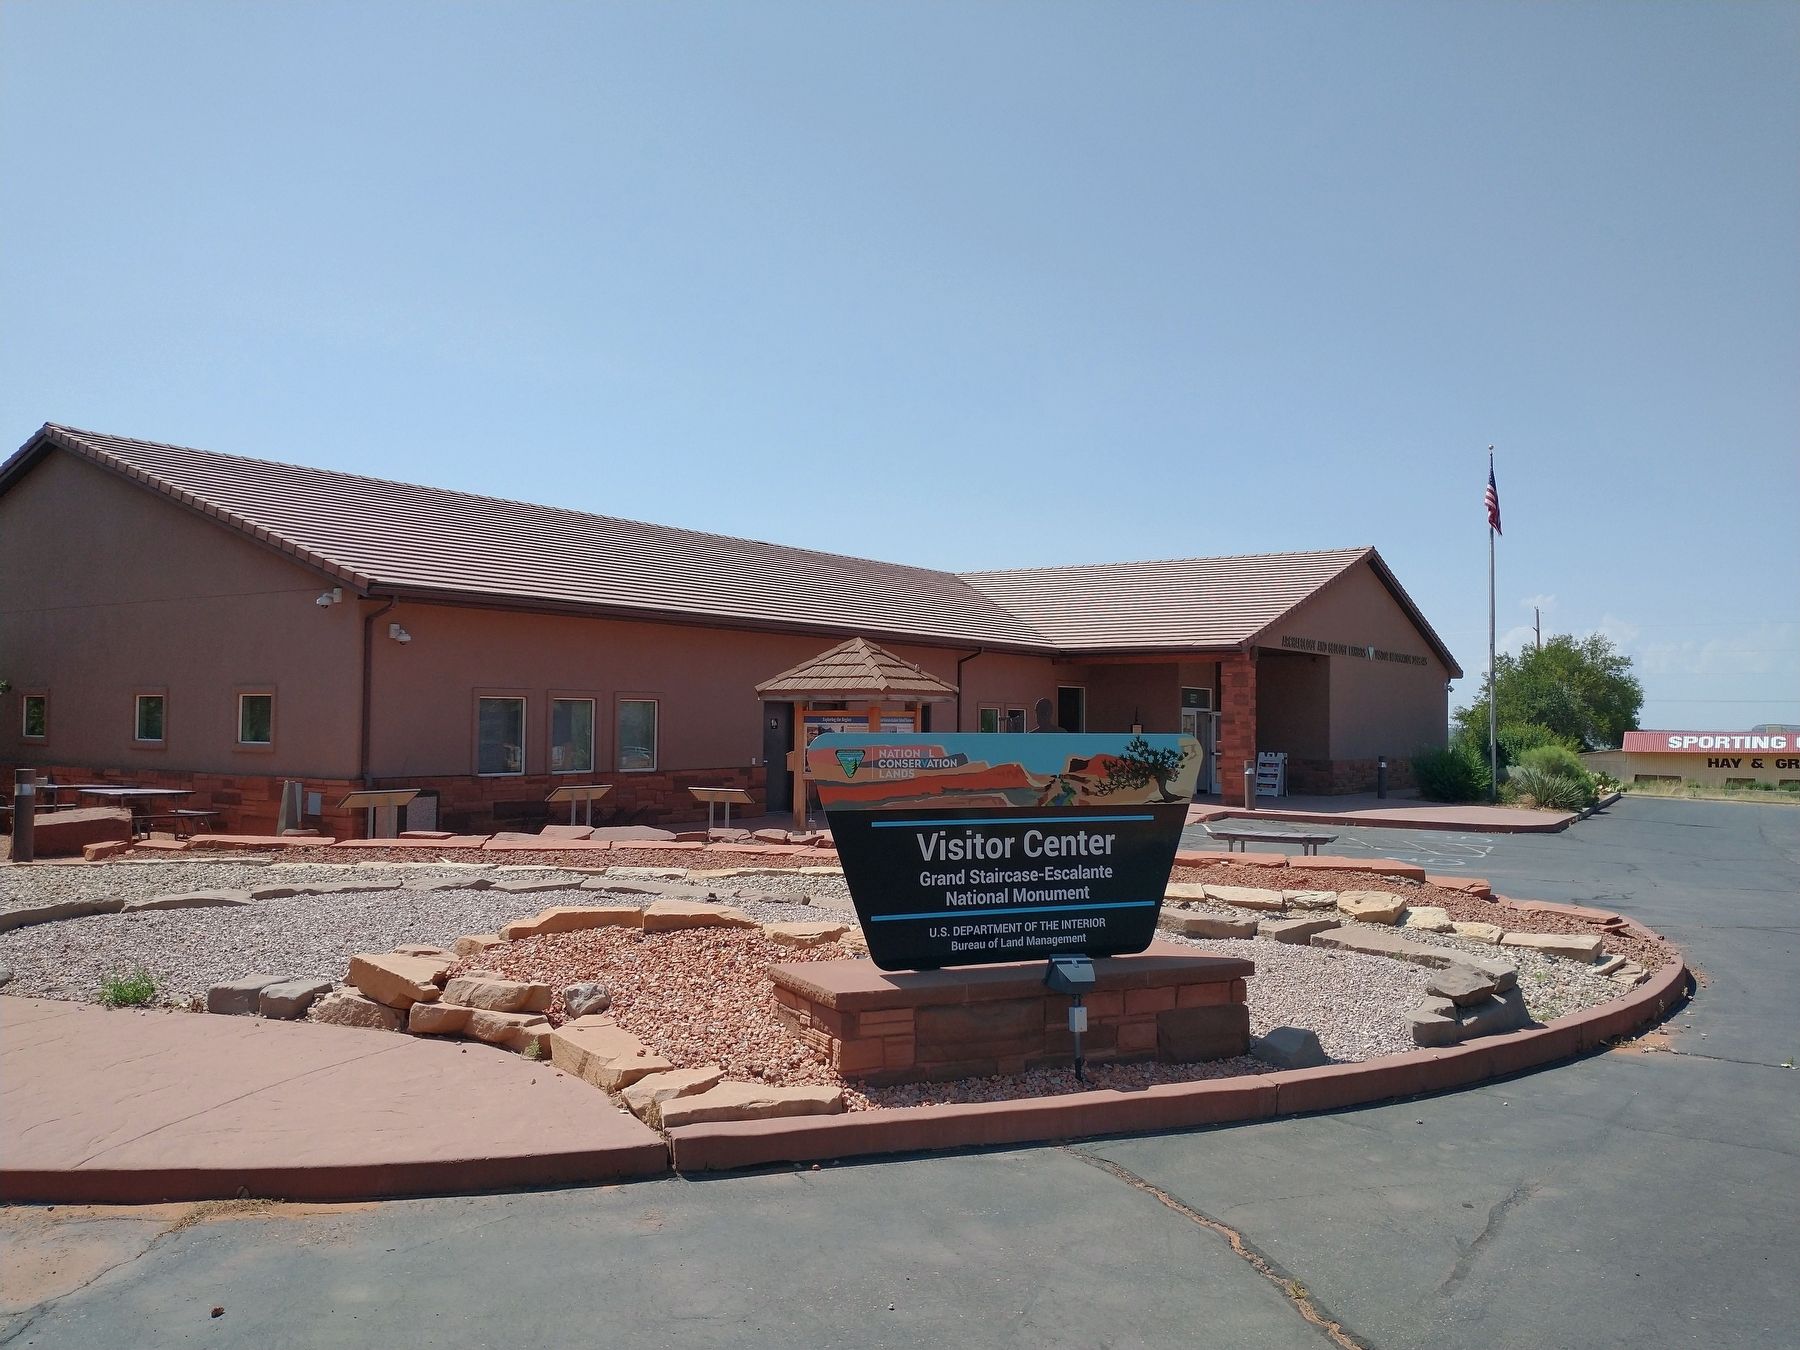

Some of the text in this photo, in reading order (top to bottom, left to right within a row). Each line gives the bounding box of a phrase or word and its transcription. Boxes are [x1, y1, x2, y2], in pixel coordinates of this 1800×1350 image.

[1668, 736, 1787, 749] SPORTING
[878, 758, 958, 769] CONSERVATION
[1707, 758, 1742, 768] HAY
[1751, 758, 1764, 769] &
[879, 768, 915, 779] LANDS
[917, 829, 1115, 861] Visitor Center
[919, 865, 1113, 888] Grand Staircase-Escalante
[945, 885, 1090, 907] National Monument
[929, 917, 1107, 938] U.S. DEPARTMENT OF THE INTERIOR
[951, 933, 1087, 951] Bureau of Land Management
